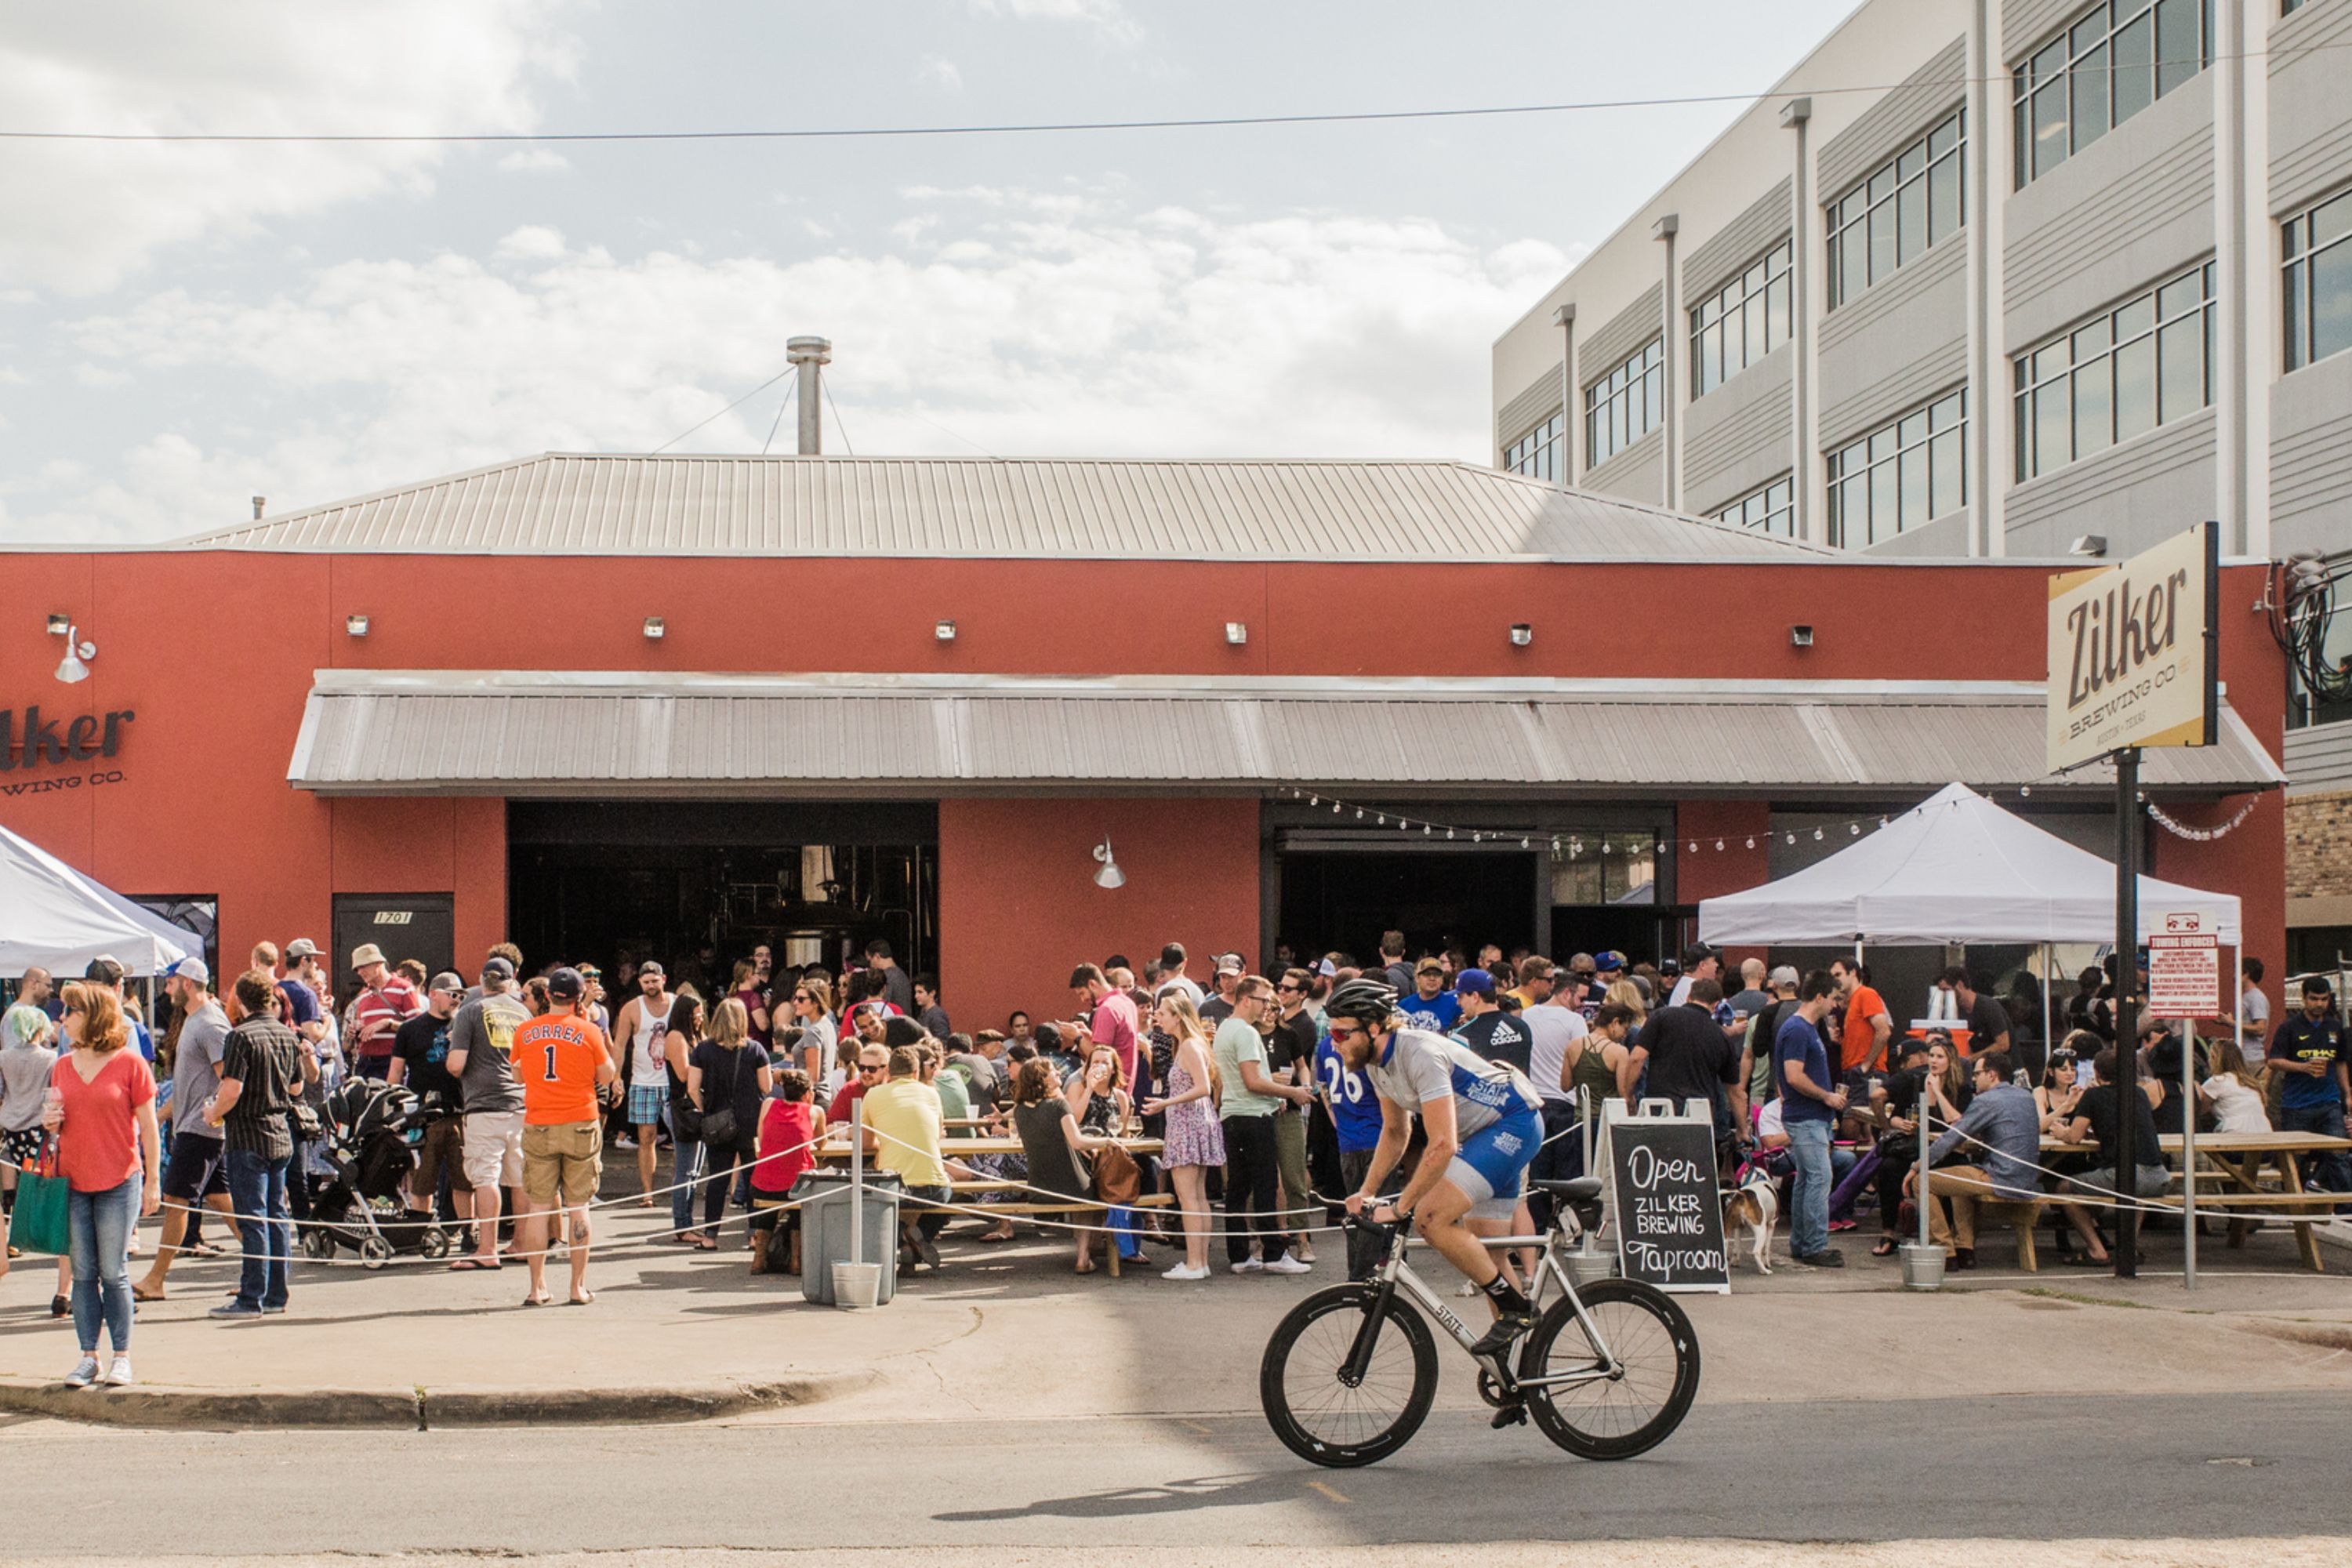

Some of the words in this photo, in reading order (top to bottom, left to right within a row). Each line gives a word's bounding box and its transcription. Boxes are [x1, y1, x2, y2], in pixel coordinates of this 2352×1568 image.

[2067, 568, 2187, 710] Zilker
[2069, 680, 2151, 739] BREWING
[2154, 665, 2176, 688] CO
[89, 771, 128, 786] CO.
[378, 913, 408, 924] 1701
[2181, 937, 2215, 947] ENFORCED
[522, 1025, 584, 1046] CORREA
[1490, 1032, 1523, 1047] adidas
[544, 1044, 558, 1082] 1
[1324, 1056, 1363, 1104] 26
[1628, 1145, 1706, 1191] Open
[1635, 1194, 1703, 1214] ZILKER
[1637, 1214, 1704, 1235] BREWING
[1626, 1240, 1726, 1283] Taproom
[1435, 1305, 1465, 1334] STATE
